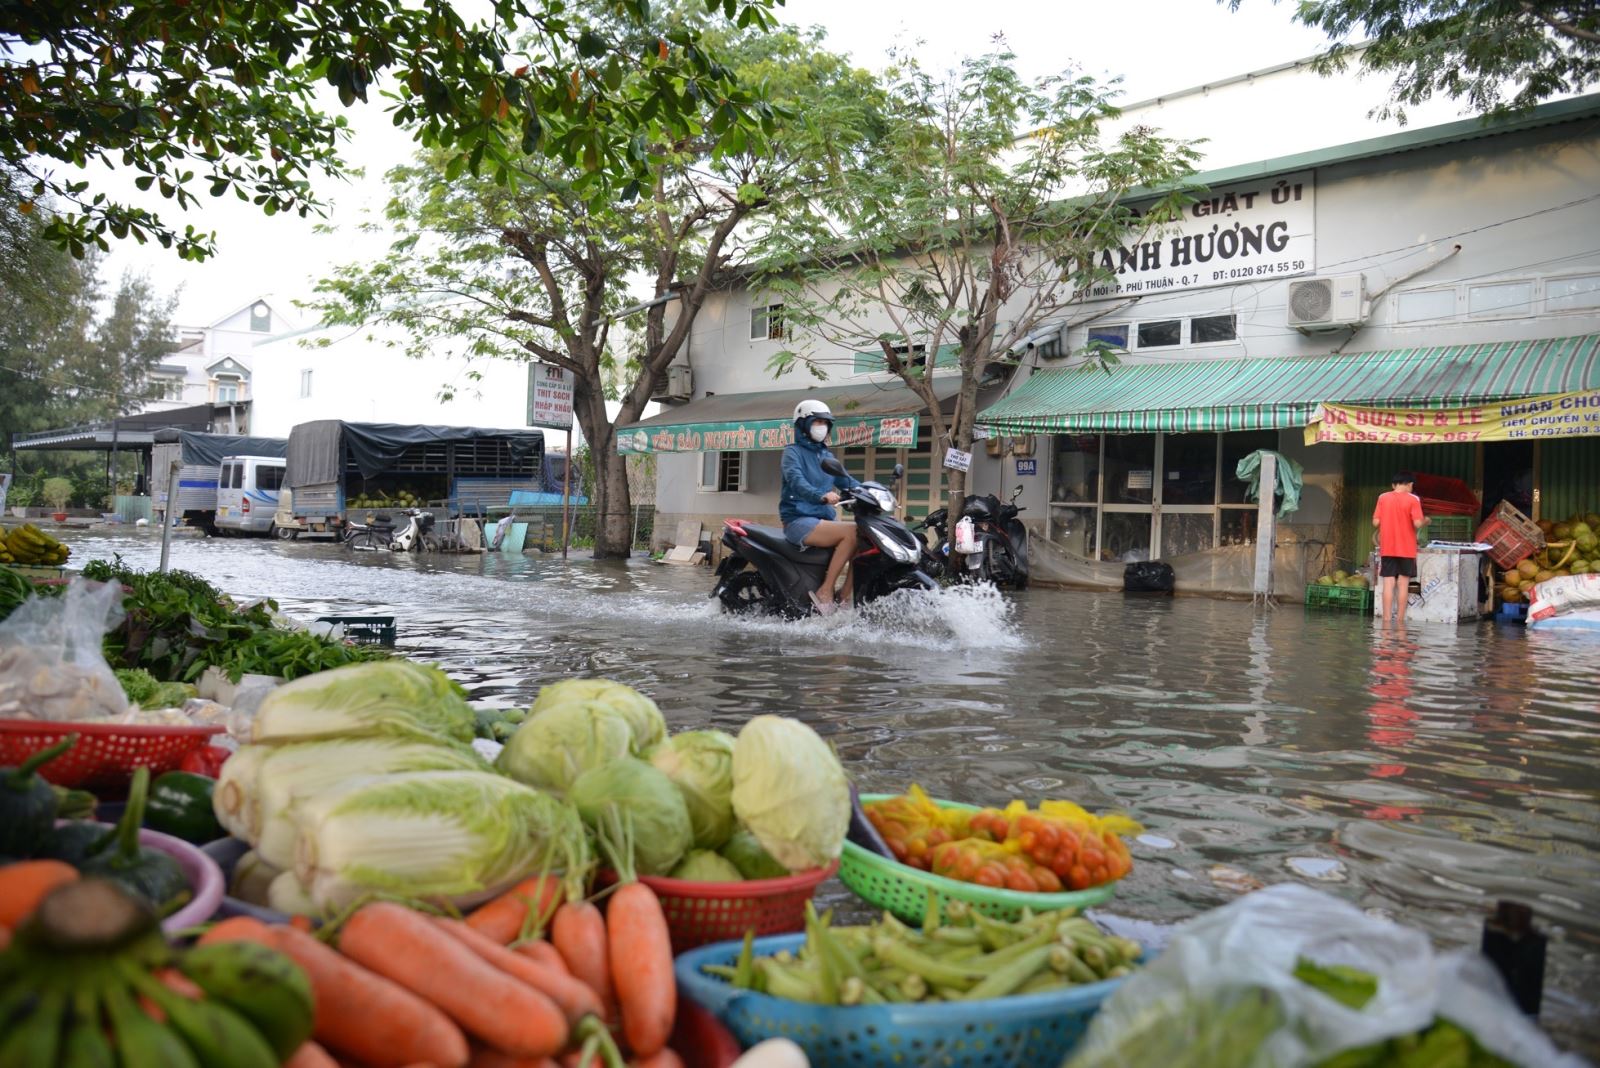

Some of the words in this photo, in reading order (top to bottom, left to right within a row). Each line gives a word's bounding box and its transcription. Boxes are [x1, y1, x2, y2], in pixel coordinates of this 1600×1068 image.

[1192, 191, 1259, 217] GIẶT
[1271, 180, 1303, 205] ỦI
[1058, 240, 1161, 281] HANH
[1170, 221, 1290, 267] HƯƠNG
[1116, 284, 1124, 294] P.
[1146, 276, 1174, 290] THUẬN
[1182, 275, 1190, 287] Q.
[1193, 273, 1199, 284] 7
[1213, 271, 1228, 280] ĐT:
[1230, 267, 1253, 279] 0120
[1256, 264, 1274, 275] 874
[1277, 262, 1289, 272] 55
[1292, 260, 1305, 270] 50
[1434, 410, 1449, 427] &
[1509, 430, 1528, 438] LH:
